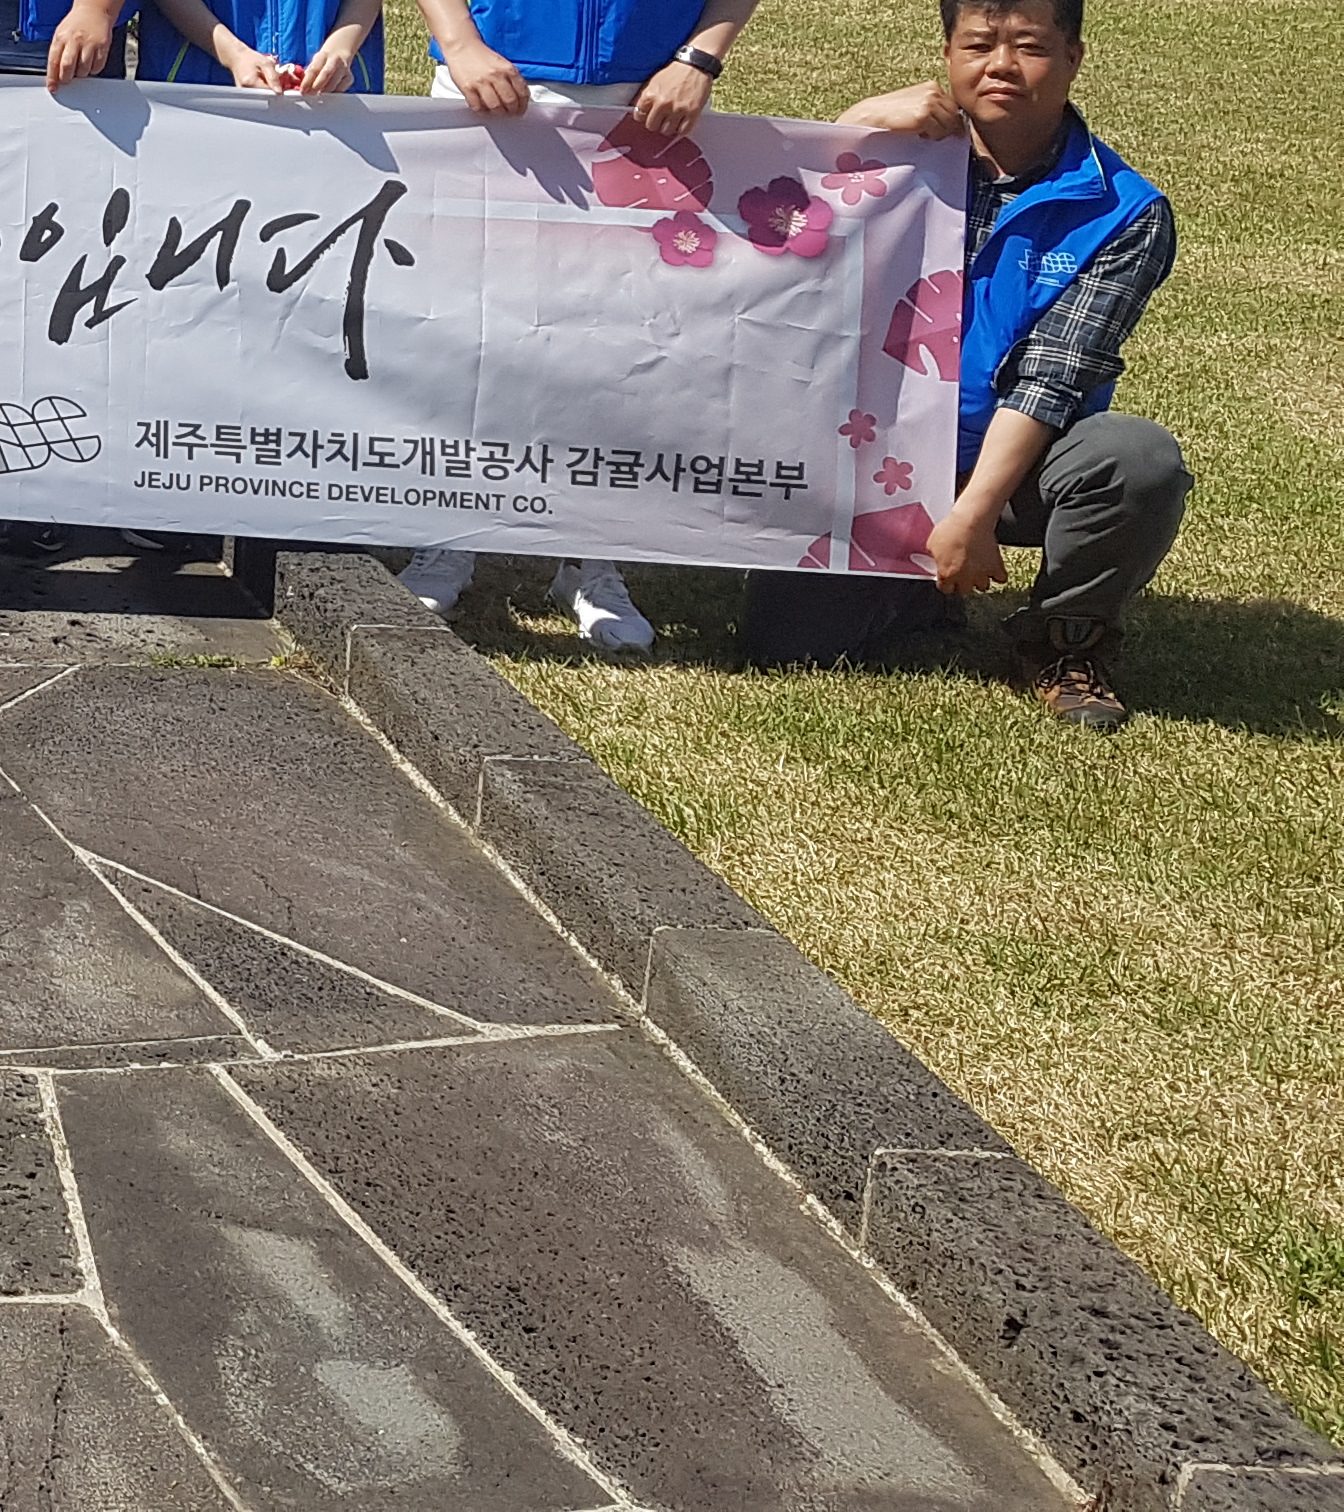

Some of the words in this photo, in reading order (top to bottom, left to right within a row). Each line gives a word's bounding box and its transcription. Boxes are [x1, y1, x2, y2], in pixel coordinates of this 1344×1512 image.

[133, 470, 192, 491] JEJU
[198, 473, 320, 501] PROVINCE
[326, 481, 507, 513] DEVELOPMENT
[511, 494, 555, 516] CO.
[134, 419, 555, 484] 제주특별자치도개발공사
[564, 444, 810, 511] 감귤사업본부
